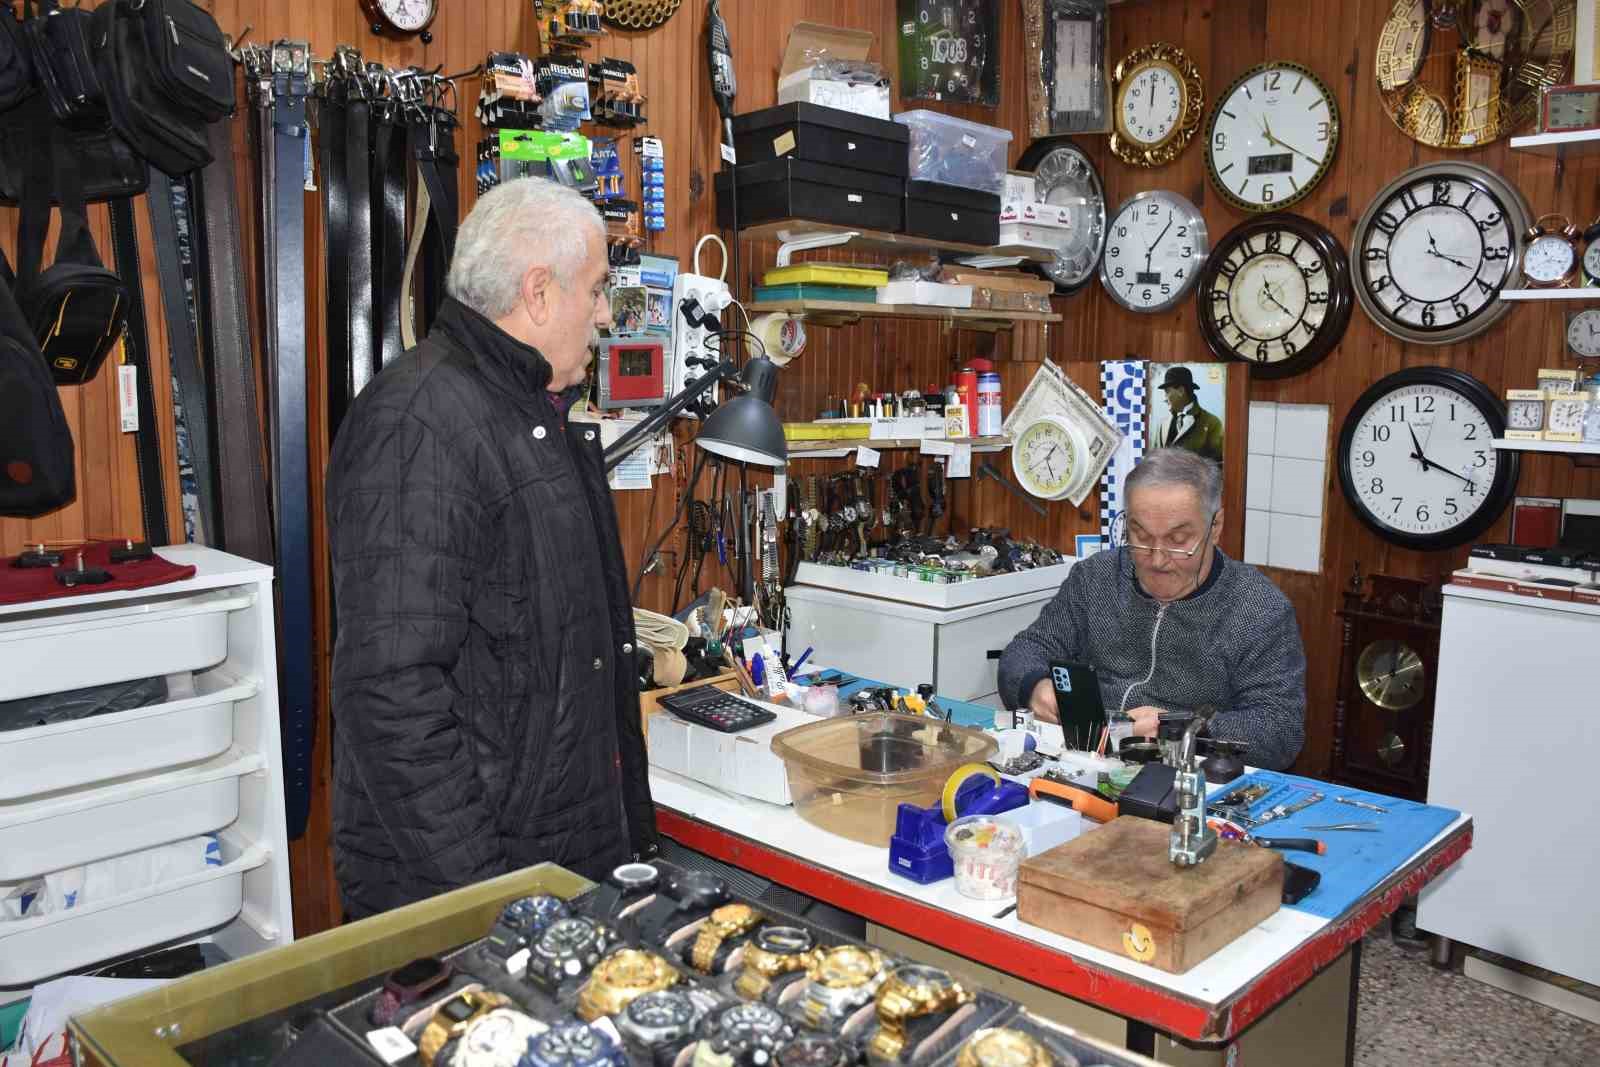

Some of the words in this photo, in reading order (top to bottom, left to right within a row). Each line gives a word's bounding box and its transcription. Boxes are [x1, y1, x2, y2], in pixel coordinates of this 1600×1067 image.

[968, 11, 976, 24] 2
[974, 35, 981, 47] 3
[550, 63, 585, 78] maxell
[921, 57, 928, 69] 8
[931, 74, 939, 86] 7
[947, 80, 955, 92] 6
[960, 75, 968, 86] 5
[1264, 72, 1280, 92] 12
[1132, 89, 1140, 97] 10
[1169, 86, 1175, 95] 2
[1138, 126, 1143, 134] 7
[1147, 128, 1153, 136] 6
[1317, 122, 1328, 141] 3
[1215, 133, 1225, 151] 9
[593, 150, 617, 159] ARTA
[1262, 184, 1273, 202] 6
[1432, 180, 1450, 204] 12
[1458, 187, 1479, 212] 1
[1401, 188, 1421, 213] 11
[1132, 211, 1138, 222] 11
[1148, 204, 1159, 215] 12
[1375, 211, 1398, 236] 10
[1479, 211, 1505, 232] 2
[1117, 227, 1127, 238] 10
[1177, 226, 1186, 237] 2
[1241, 239, 1257, 260] 11
[1265, 232, 1280, 252] 12
[1111, 247, 1119, 257] 9
[1181, 247, 1192, 258] 3
[1366, 248, 1387, 260] 9
[1484, 247, 1508, 260] 3
[1114, 267, 1124, 278] 8
[1174, 269, 1184, 278] 4
[1220, 259, 1239, 279] 10
[1302, 260, 1322, 277] 2
[1126, 283, 1135, 294] 7
[1161, 284, 1170, 294] 5
[1371, 276, 1392, 292] 8
[1476, 277, 1493, 295] 4
[1142, 289, 1151, 300] 6
[1210, 289, 1229, 300] 9
[1309, 292, 1328, 304] 3
[1393, 294, 1411, 317] 7
[1451, 296, 1468, 319] 5
[1216, 315, 1232, 329] 8
[1421, 304, 1435, 326] 6
[1300, 319, 1319, 335] 4
[1232, 333, 1248, 352] 7
[1281, 334, 1296, 355] 5
[1256, 341, 1268, 362] 6
[1415, 395, 1435, 413] 12
[1391, 406, 1404, 422] 11
[1450, 404, 1455, 421] 1
[1373, 425, 1390, 441] 10
[1463, 424, 1476, 440] 2
[1362, 451, 1375, 467] 9
[1473, 451, 1487, 467] 3
[1371, 478, 1383, 494] 8
[1463, 480, 1477, 496] 4
[1391, 497, 1403, 513] 7
[1444, 499, 1458, 515] 5
[1416, 505, 1429, 522] 6
